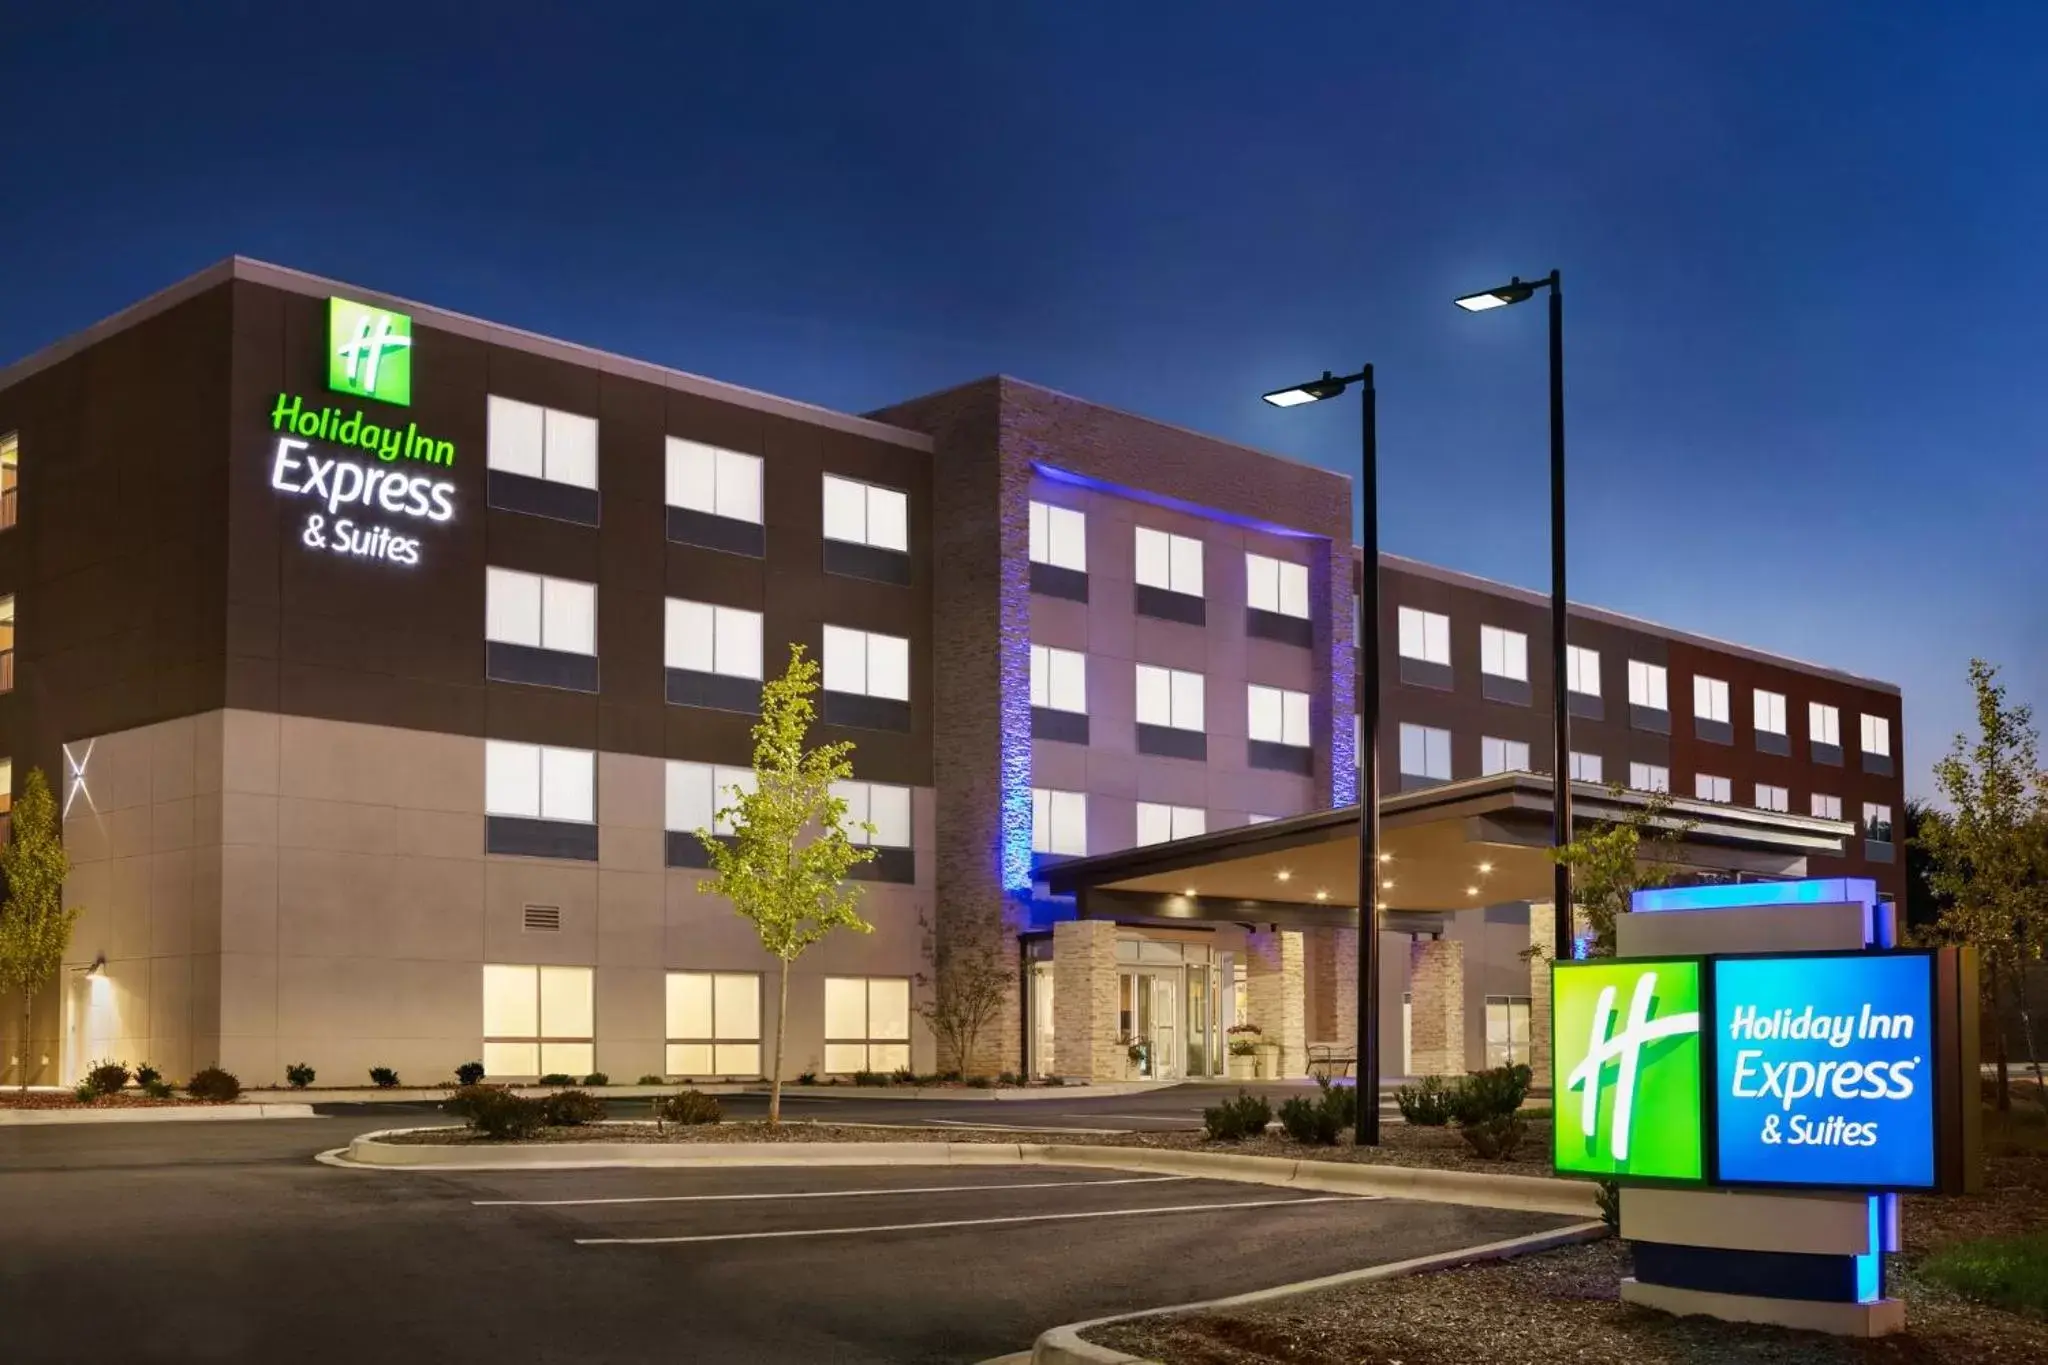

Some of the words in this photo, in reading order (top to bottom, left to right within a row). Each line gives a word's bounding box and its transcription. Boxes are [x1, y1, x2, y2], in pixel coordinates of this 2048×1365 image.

[272, 392, 402, 461] Holiday
[405, 422, 455, 467] Inn
[272, 437, 456, 521] Express
[302, 514, 326, 548] &
[331, 519, 420, 565] Suites
[1729, 1004, 1853, 1048] Holiday
[1858, 1003, 1914, 1039] Inn
[1760, 1114, 1782, 1144] &
[1788, 1114, 1878, 1147] Suites
